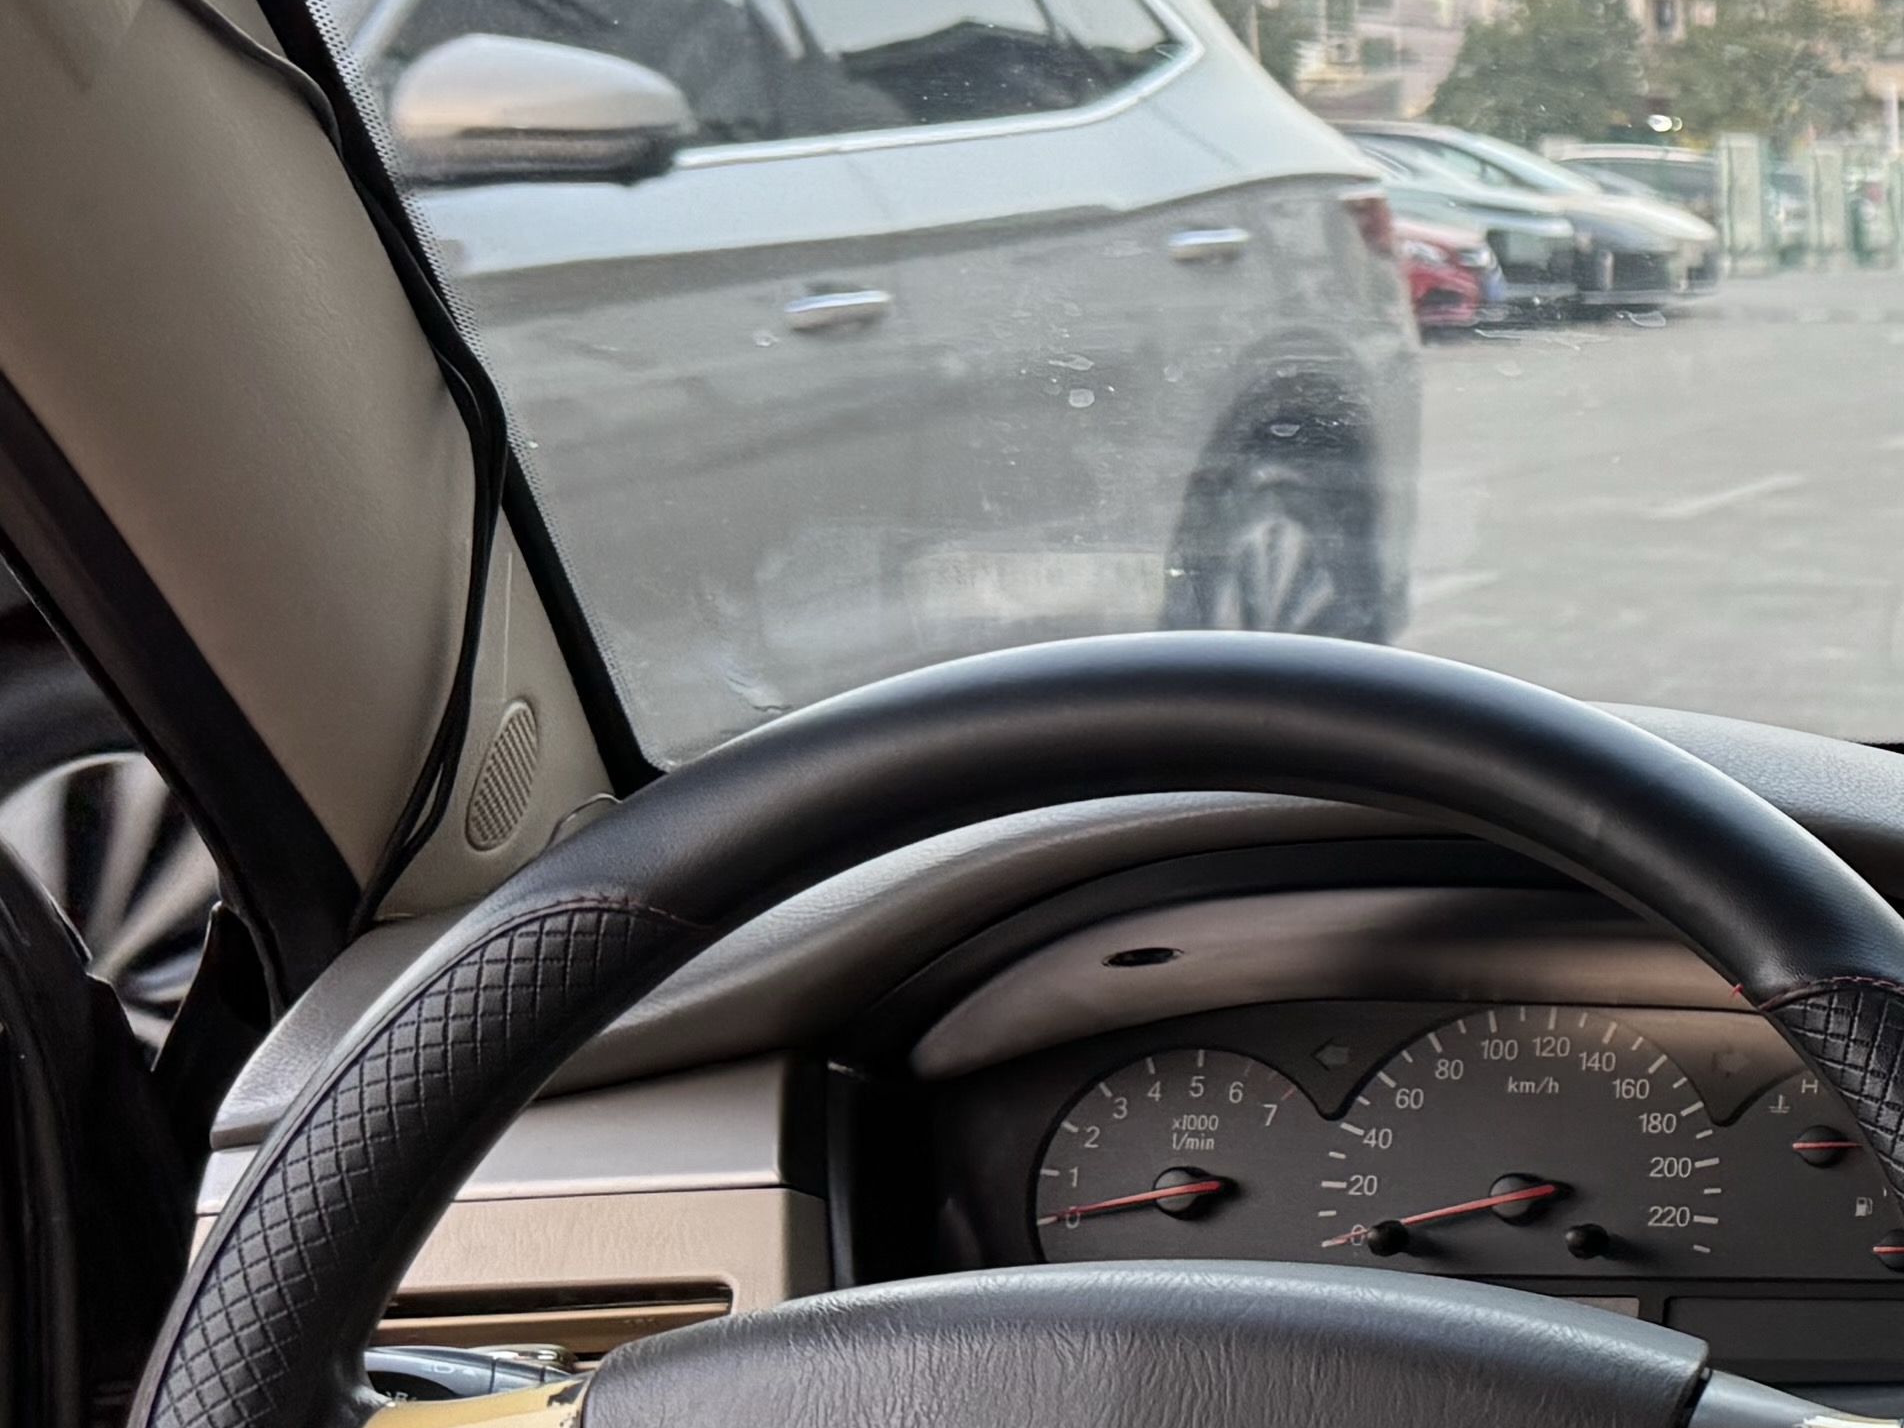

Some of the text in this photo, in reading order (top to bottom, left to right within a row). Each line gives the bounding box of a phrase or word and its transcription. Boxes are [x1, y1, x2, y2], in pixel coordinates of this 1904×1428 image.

[1480, 1039, 1519, 1061] 100
[1532, 1036, 1571, 1058] 120
[1434, 1058, 1464, 1080] 80
[1578, 1051, 1617, 1073] 140
[1147, 1081, 1162, 1102] 4
[1189, 1075, 1205, 1098] 5
[1228, 1081, 1244, 1104] 6
[1507, 1075, 1560, 1095] km/h
[1612, 1078, 1650, 1100] 160
[1800, 1077, 1819, 1095] H
[1112, 1097, 1128, 1119] 3
[1394, 1087, 1425, 1110] 60
[1262, 1104, 1278, 1126] 7
[1638, 1113, 1677, 1134] 180
[1084, 1126, 1101, 1149] 2
[1362, 1128, 1393, 1149] 40
[1068, 1167, 1079, 1187] 1
[1650, 1157, 1693, 1179] 200
[1348, 1174, 1378, 1196] 20
[1065, 1206, 1081, 1229] 0
[1647, 1206, 1690, 1227] 220
[1351, 1224, 1367, 1246] 0
